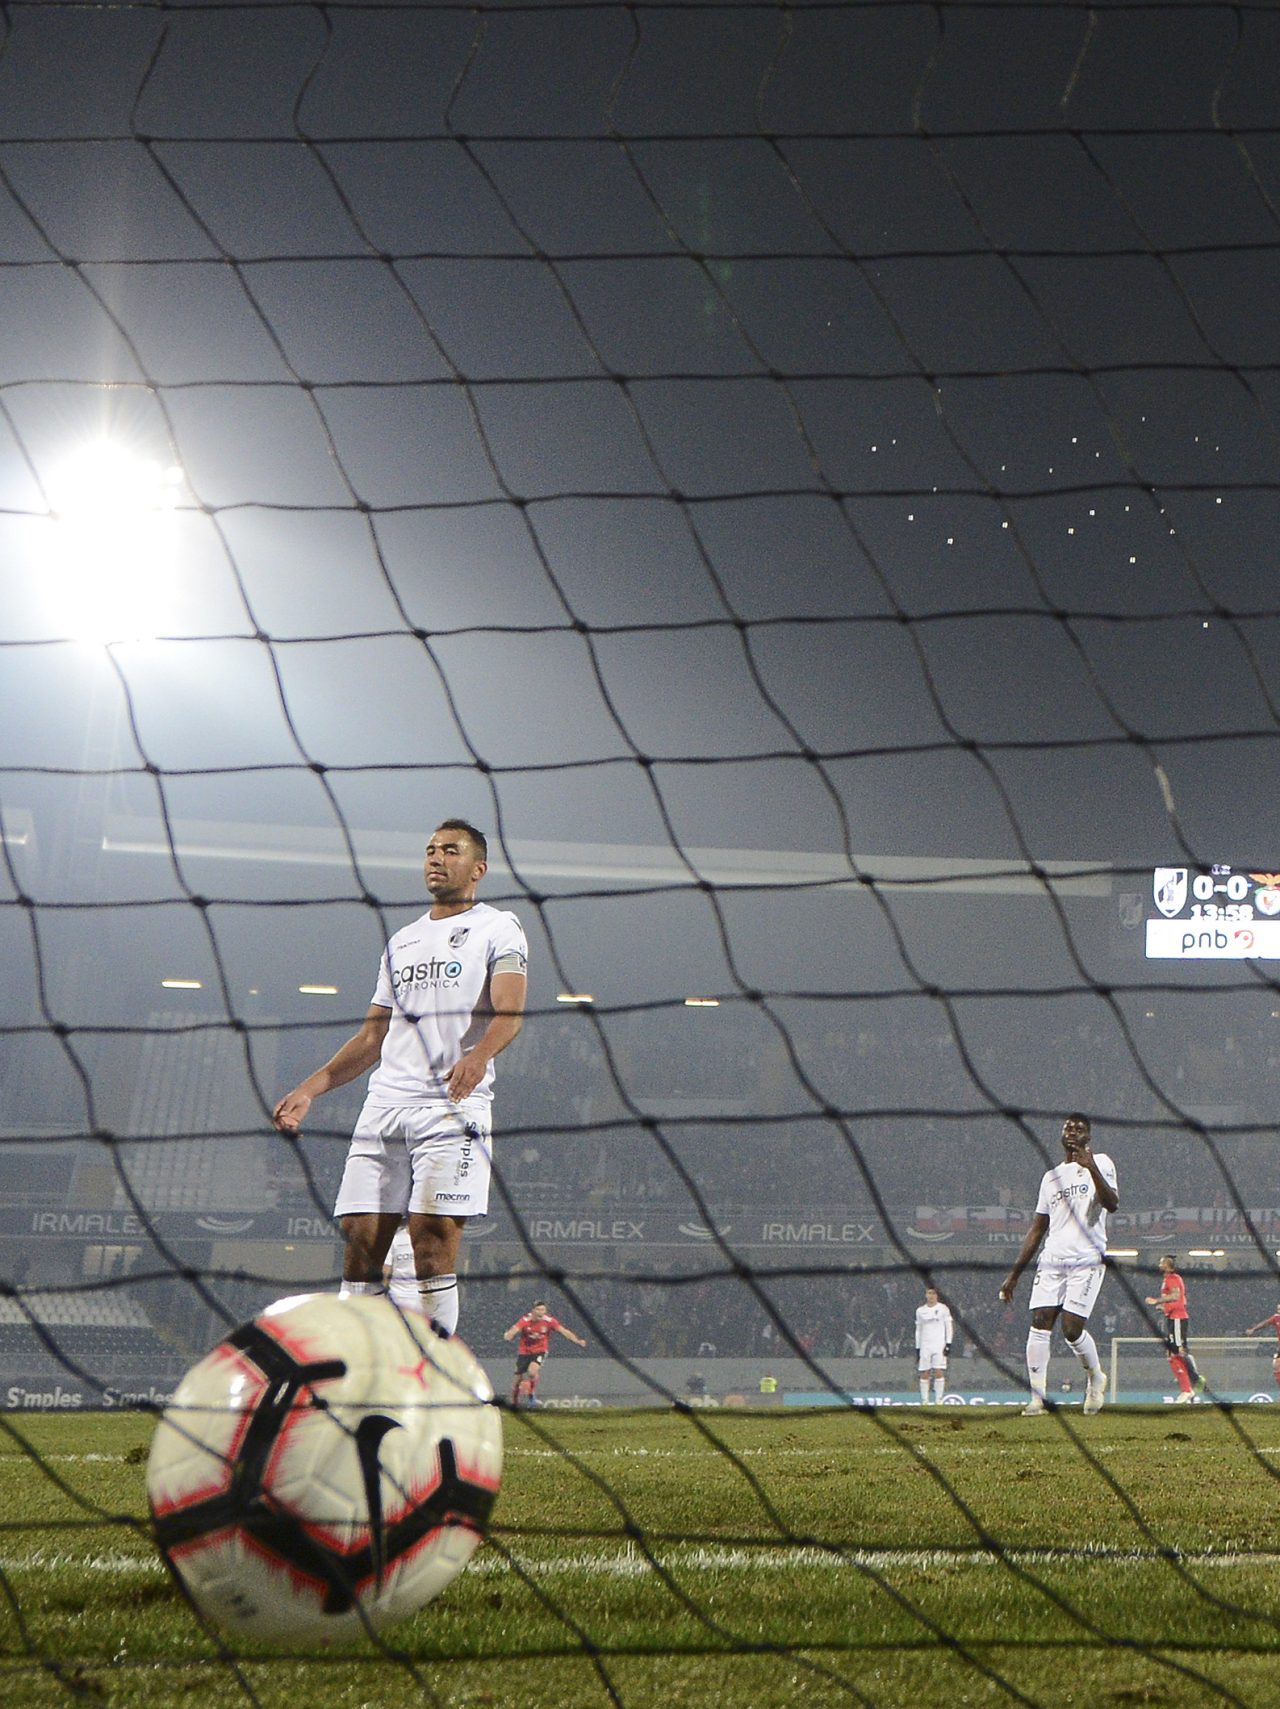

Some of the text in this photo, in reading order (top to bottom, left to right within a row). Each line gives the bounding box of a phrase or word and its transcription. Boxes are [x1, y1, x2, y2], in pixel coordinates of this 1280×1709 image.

[1193, 874, 1248, 901] 0-0
[1181, 929, 1228, 954] pnb
[392, 956, 462, 989] castro
[530, 1220, 645, 1240] IRMALEX
[762, 1223, 874, 1242] IRMALEX
